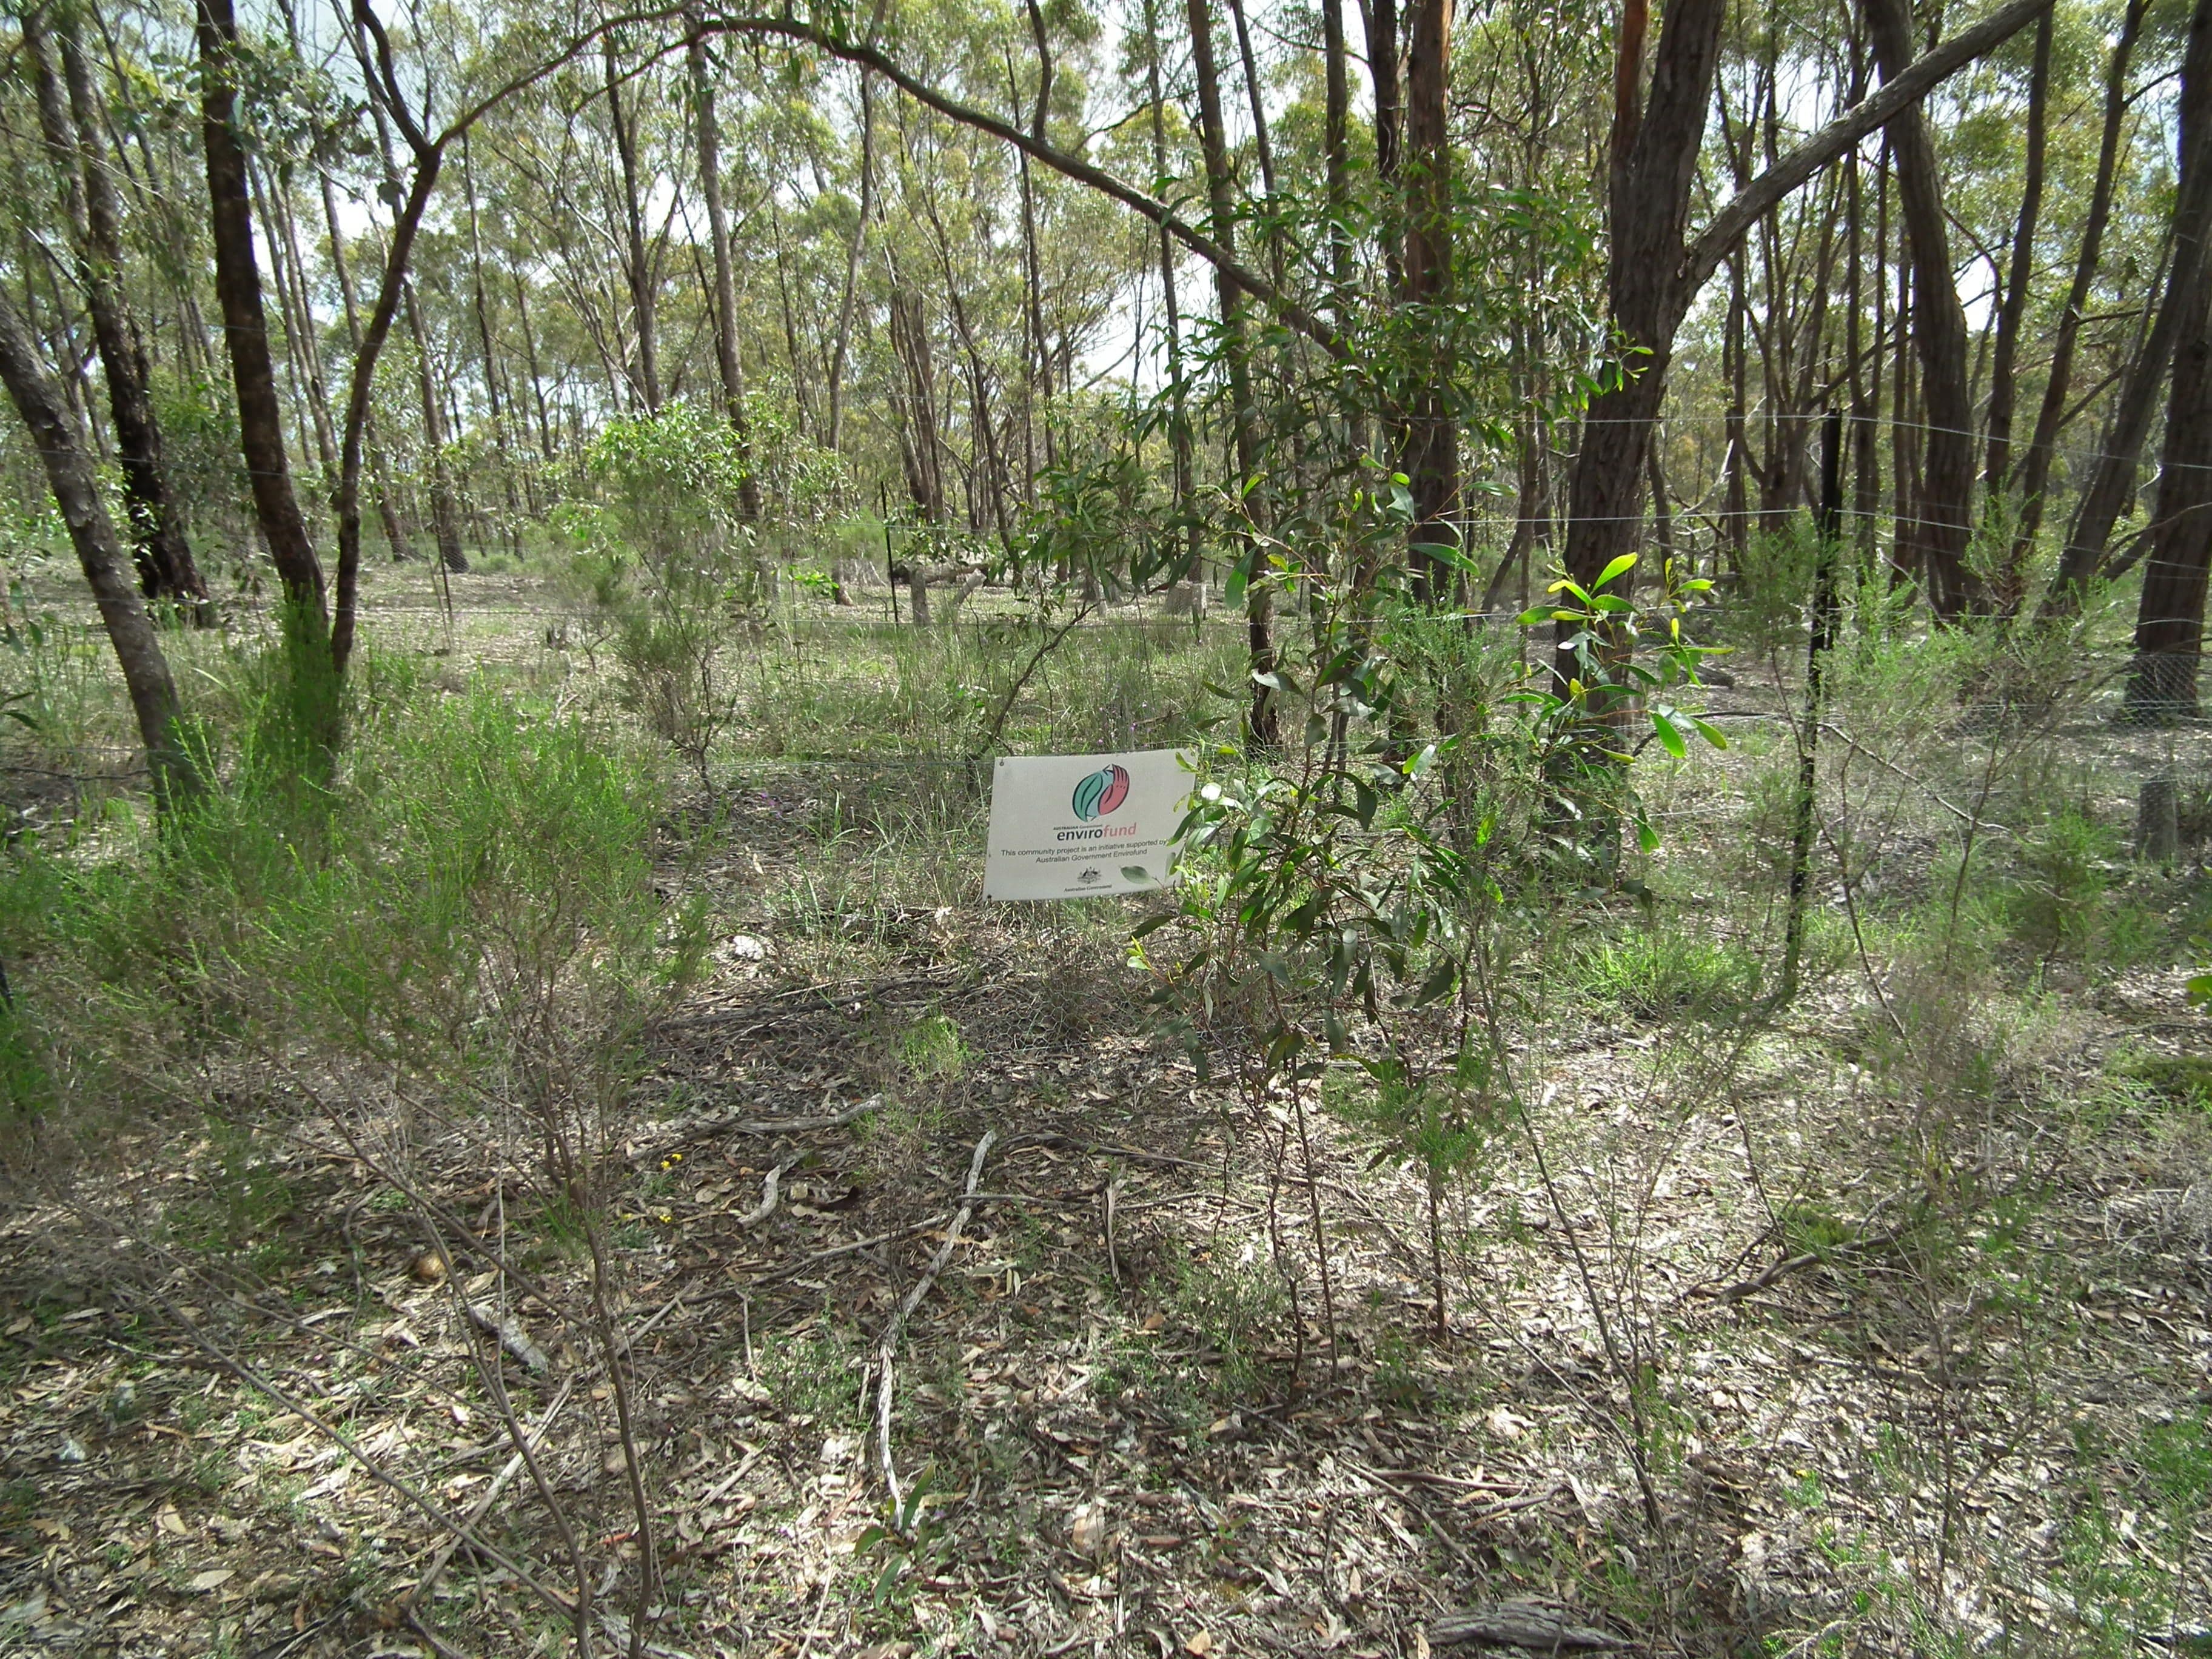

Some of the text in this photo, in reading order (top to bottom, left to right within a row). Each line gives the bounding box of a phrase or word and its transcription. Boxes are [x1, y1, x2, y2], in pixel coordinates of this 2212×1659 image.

[1057, 822, 1137, 841] envirofund
[1127, 840, 1158, 849] supported
[1071, 852, 1111, 861] Government
[1113, 849, 1147, 857] Envirofund
